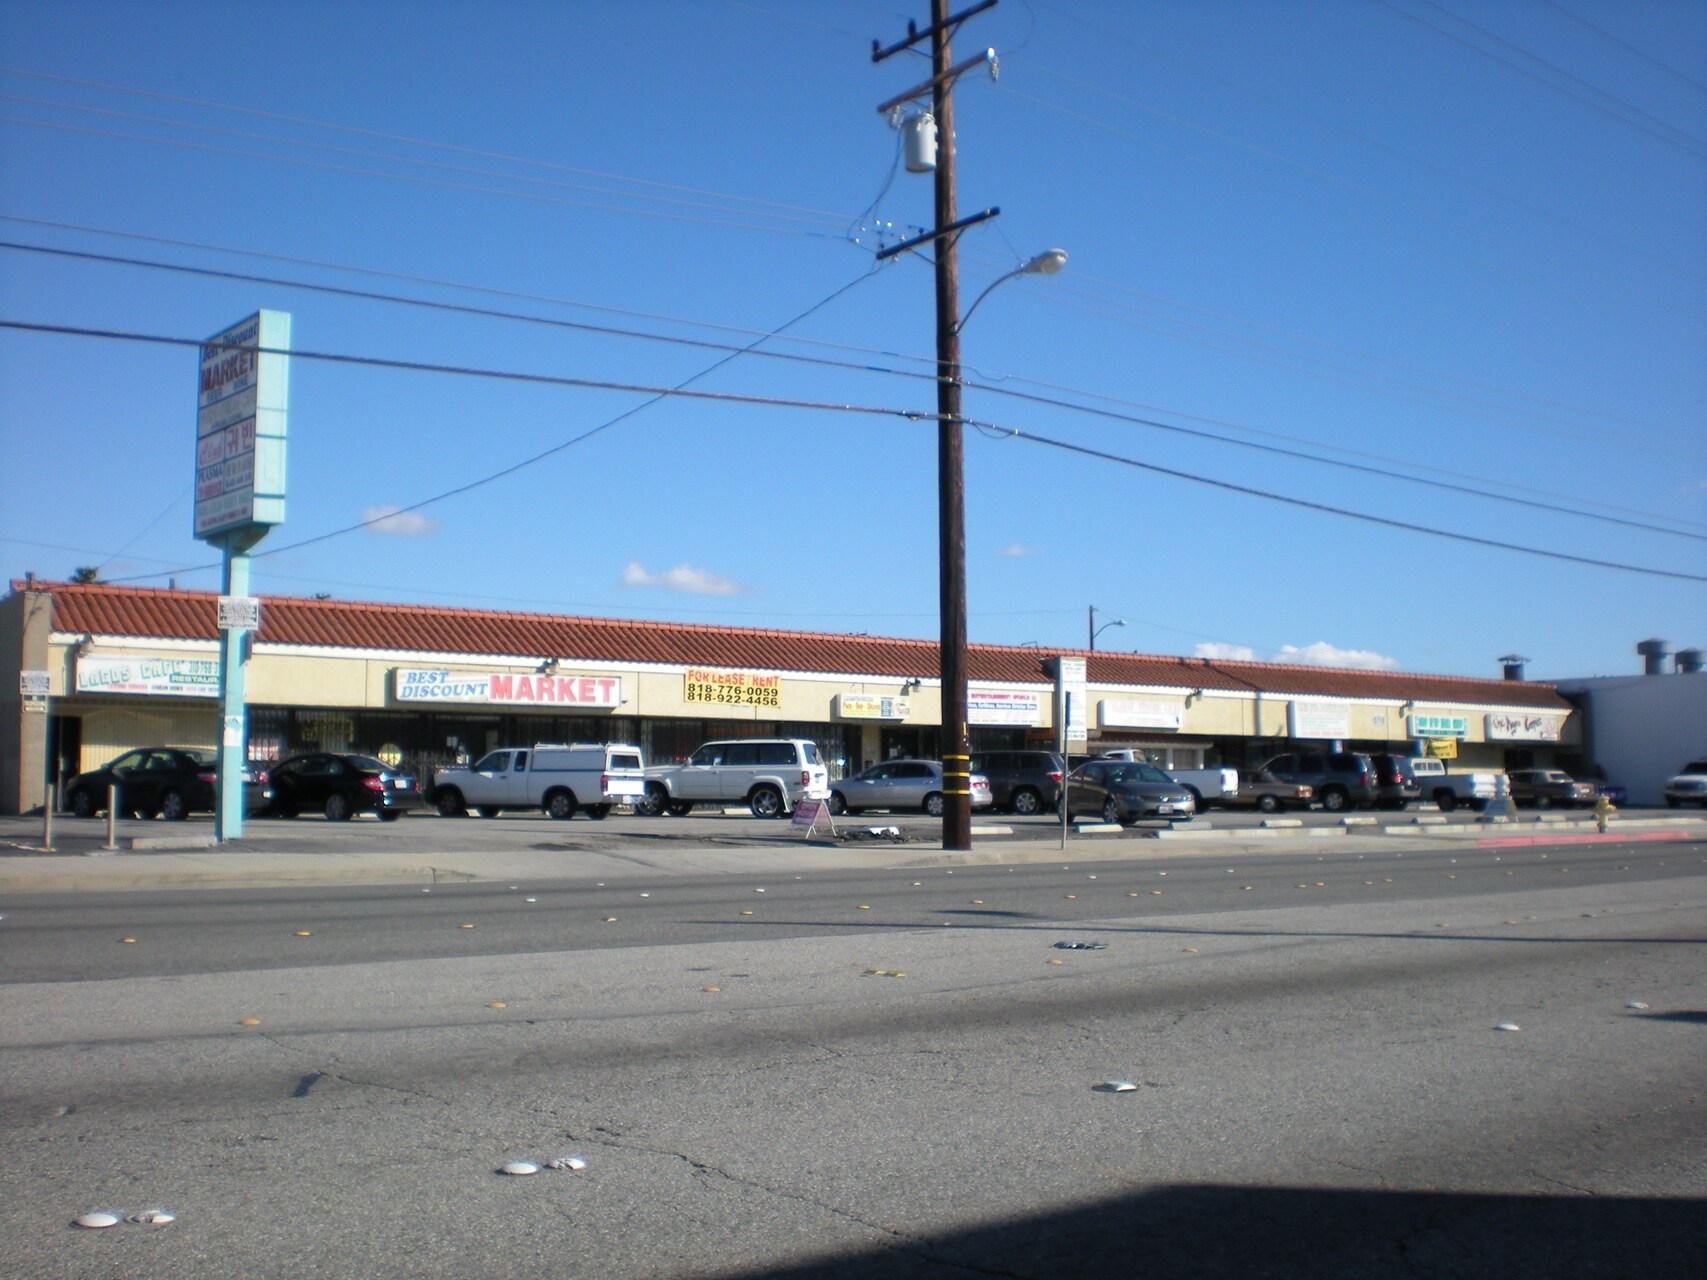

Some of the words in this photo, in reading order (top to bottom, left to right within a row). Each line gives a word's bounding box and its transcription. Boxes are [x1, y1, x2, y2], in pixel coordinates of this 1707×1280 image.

[200, 346, 254, 394] MARKET
[78, 667, 132, 688] LAGOS
[406, 671, 449, 684] BEST
[688, 669, 709, 683] FOR
[712, 672, 745, 686] LEASE
[752, 675, 780, 687] RENT
[400, 683, 488, 698] DISCOUNT
[489, 675, 616, 703] MARKET
[687, 683, 779, 697] 818-776-0059
[687, 691, 778, 706] 818-922-4456
